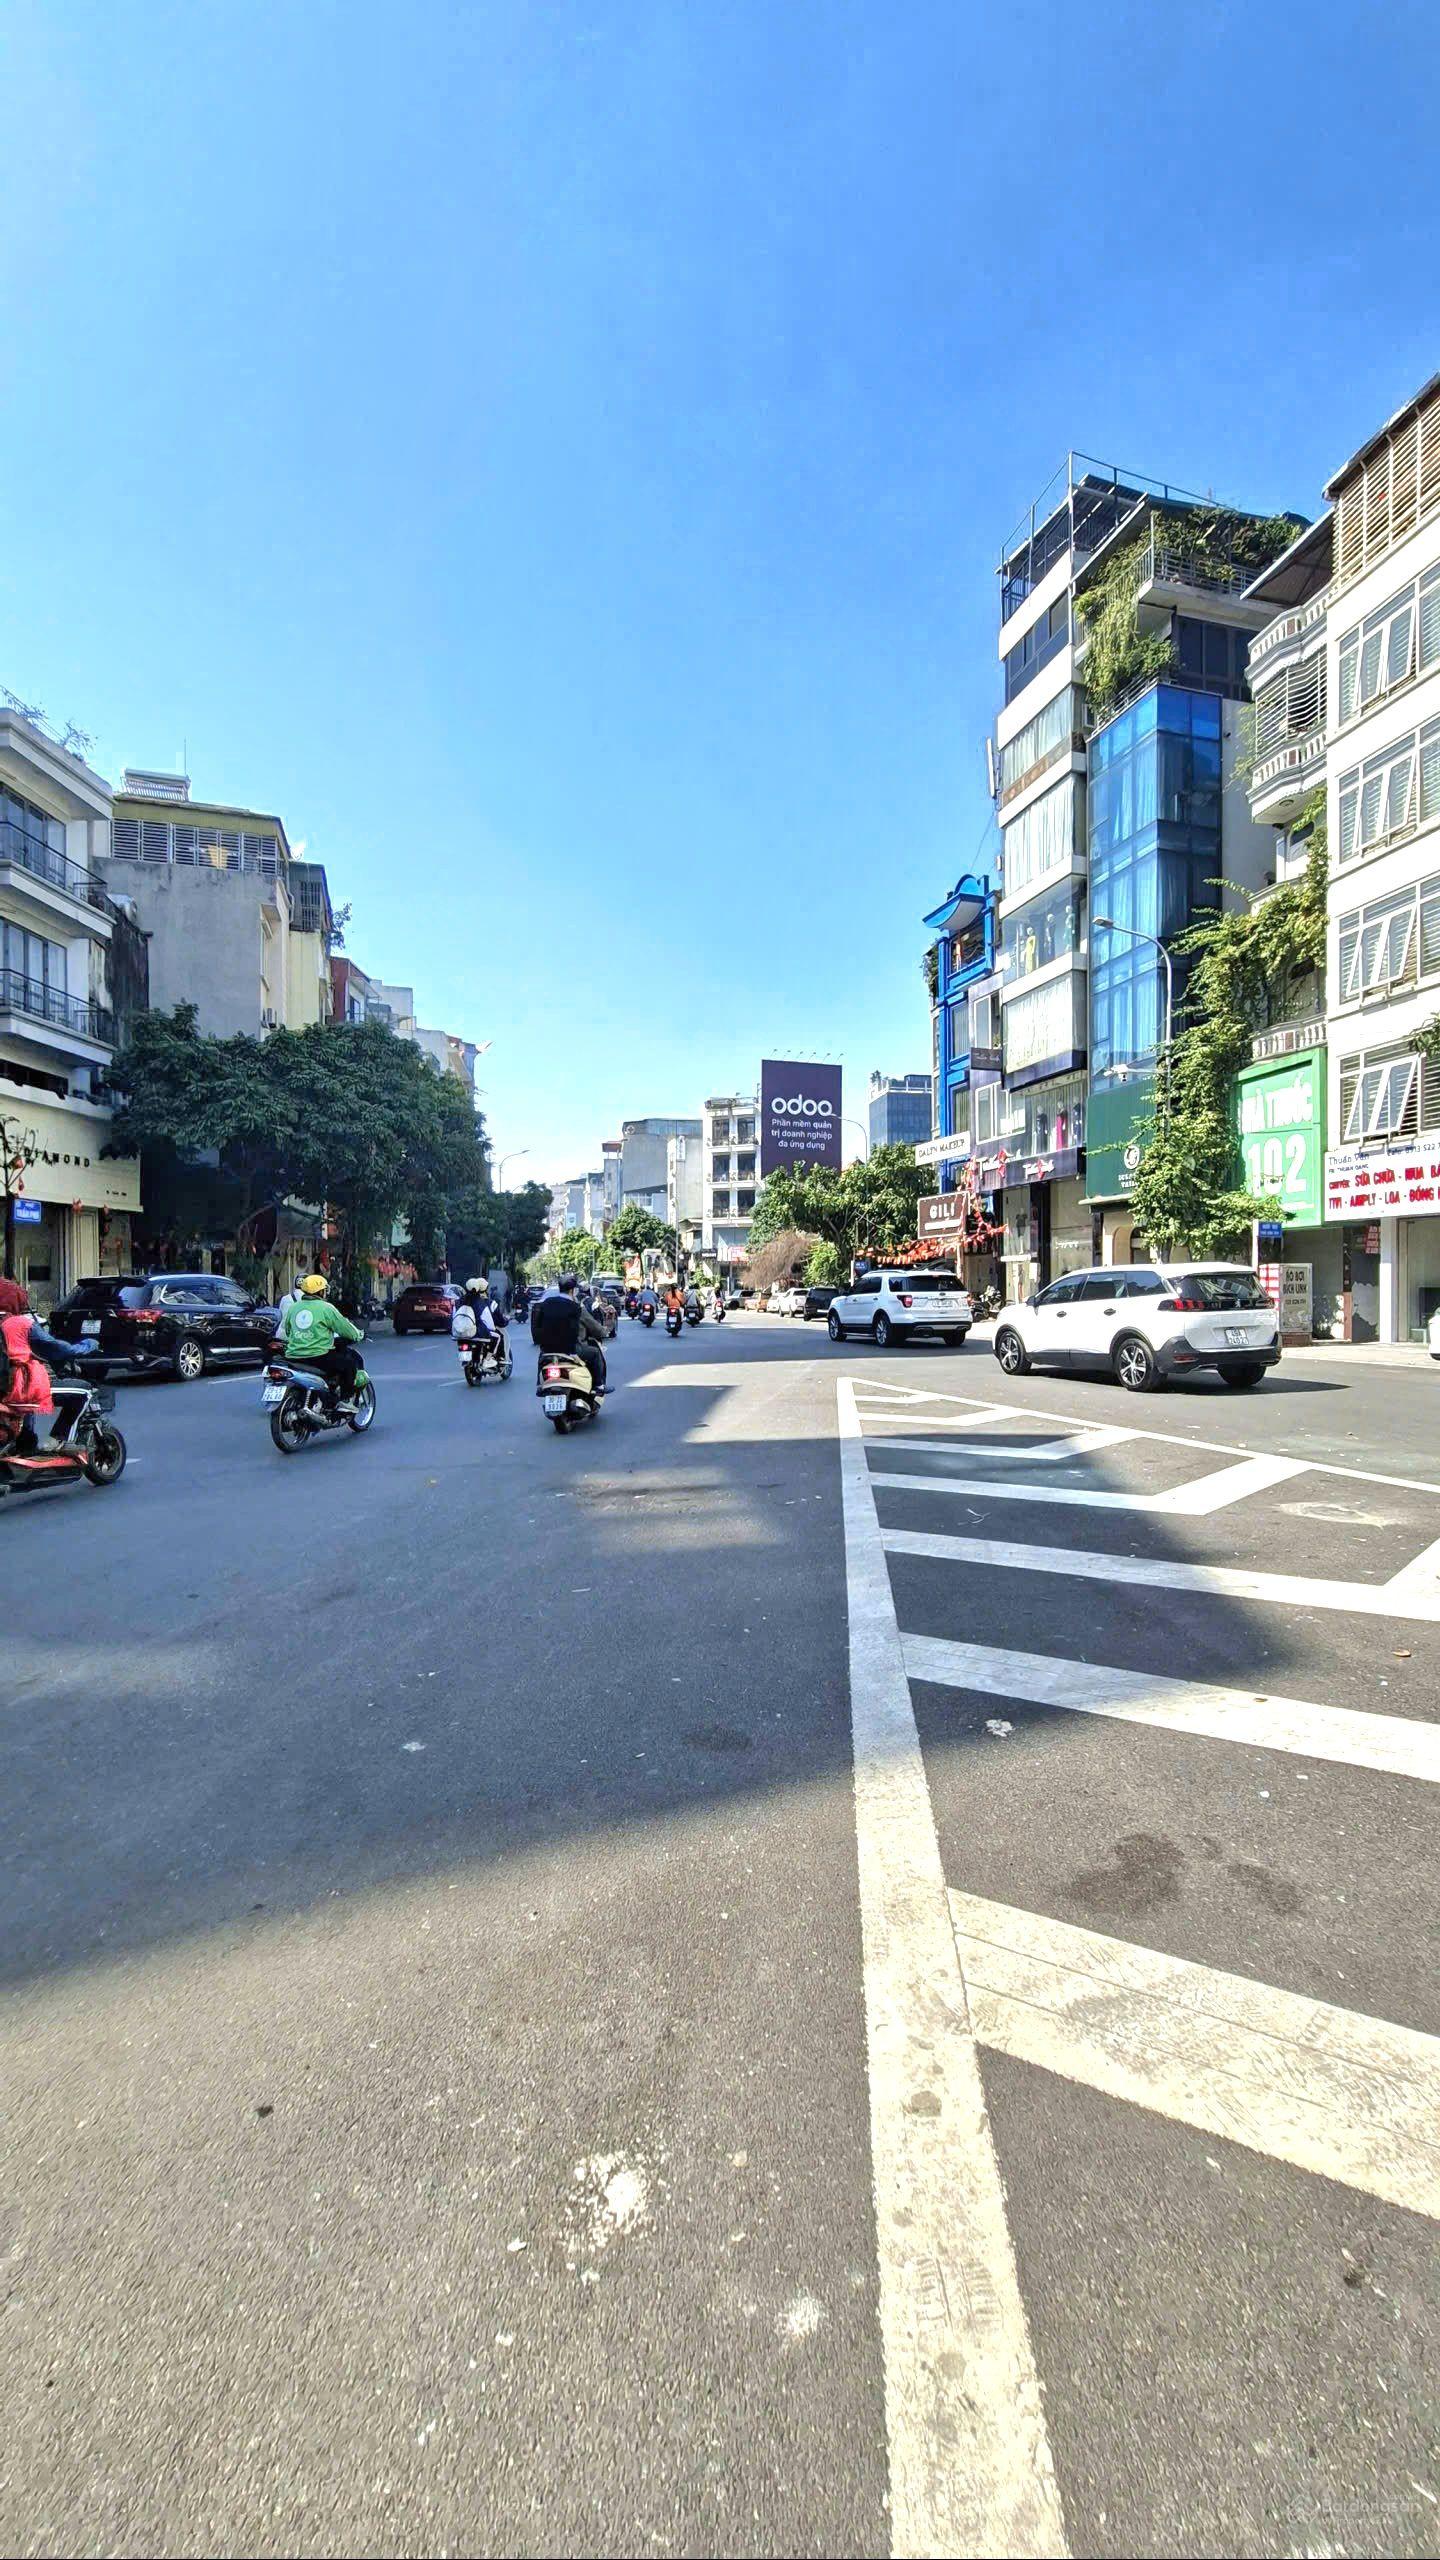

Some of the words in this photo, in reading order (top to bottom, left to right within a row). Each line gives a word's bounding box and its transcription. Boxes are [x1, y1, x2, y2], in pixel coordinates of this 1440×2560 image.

[771, 1094, 833, 1116] odoo
[771, 1118, 791, 1127] Phần
[792, 1119, 812, 1128] mềm
[812, 1120, 832, 1130] quản
[771, 1129, 780, 1138] trị
[781, 1130, 805, 1138] doanh
[807, 1131, 833, 1140] nghiệp
[789, 1140, 805, 1149] ứng
[806, 1141, 826, 1151] dụng
[1248, 1134, 1307, 1198] 102
[1385, 1191, 1401, 1204] LOA
